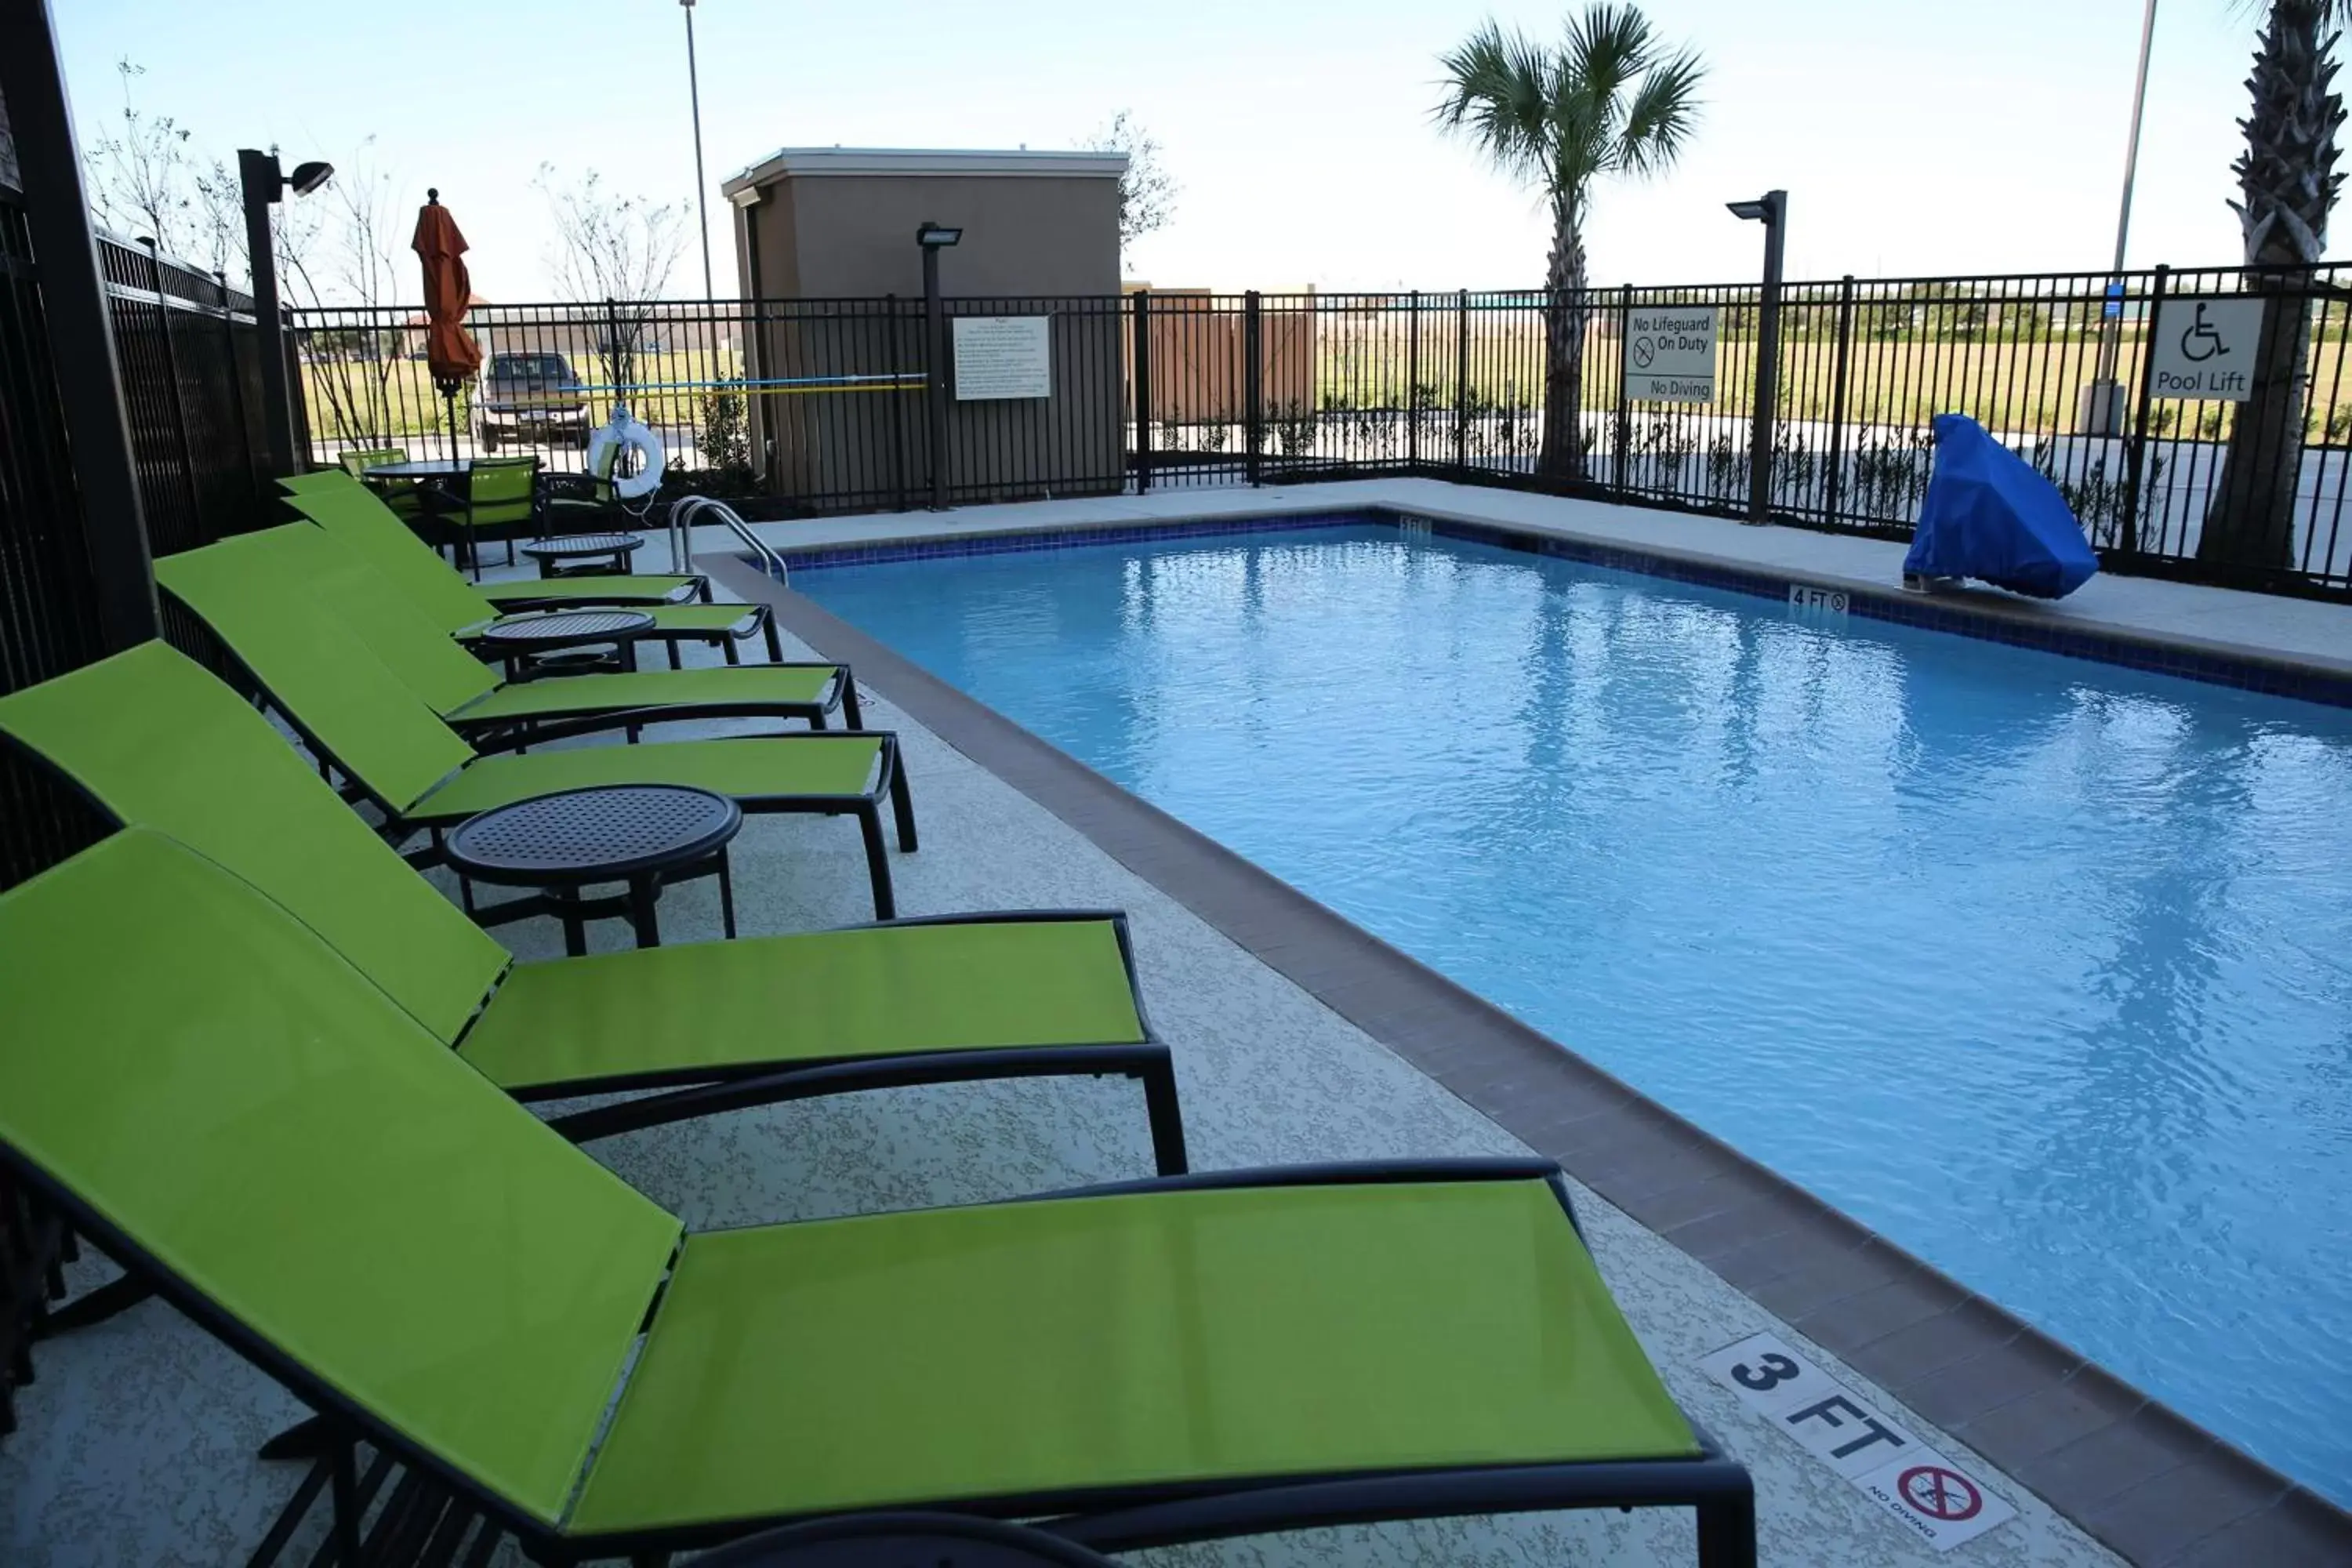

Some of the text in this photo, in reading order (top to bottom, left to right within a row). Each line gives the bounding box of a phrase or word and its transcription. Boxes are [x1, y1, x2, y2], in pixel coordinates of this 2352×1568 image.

[1633, 316, 1709, 334] No Lifeguard
[1658, 336, 1708, 354] On Duty
[1650, 380, 1709, 400] No Diving
[2158, 371, 2245, 391] Pool Lift
[1794, 590, 1828, 609] 4 FT
[1731, 1352, 1906, 1459] 3 FT
[1868, 1486, 1937, 1538] NO DIVING
